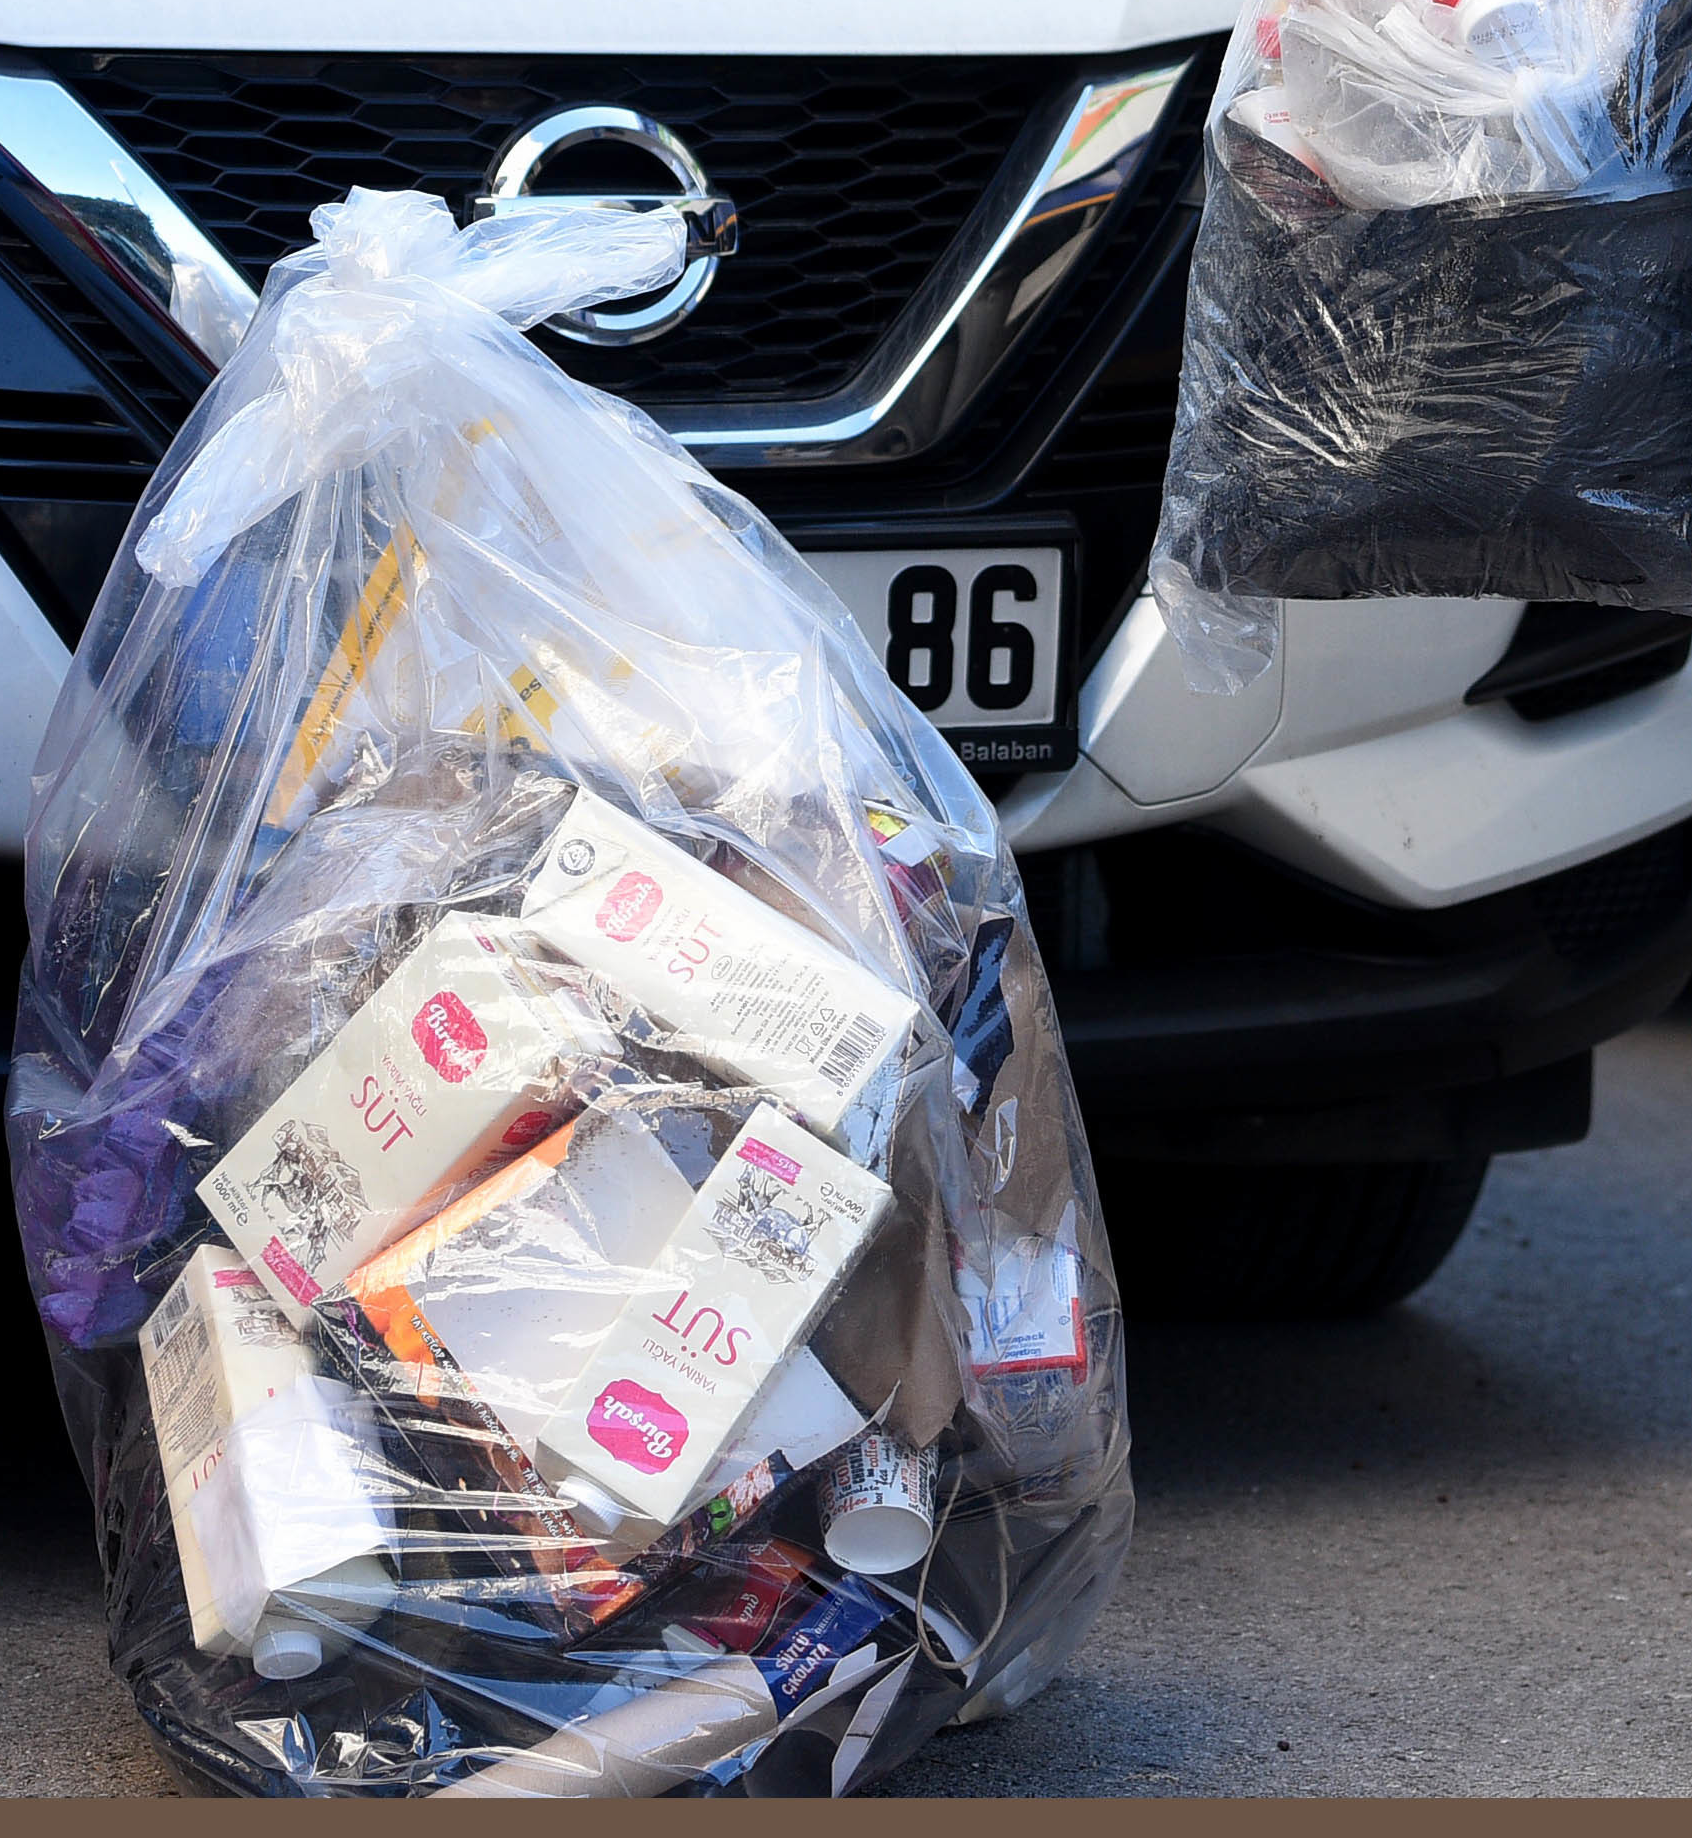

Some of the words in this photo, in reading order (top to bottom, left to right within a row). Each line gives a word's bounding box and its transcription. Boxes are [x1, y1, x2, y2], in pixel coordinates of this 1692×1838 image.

[886, 564, 1037, 712] 86
[960, 741, 1052, 762] Balaban
[668, 914, 723, 983] SÜT
[380, 1053, 404, 1092] YARIM
[350, 1073, 414, 1153] SÜT
[210, 1177, 233, 1202] 1000
[226, 1201, 240, 1215] ml
[843, 1197, 867, 1217] 1000
[408, 1313, 426, 1333] TAT
[652, 1290, 752, 1366] SÜT
[642, 1337, 679, 1370] YAĞLI
[678, 1361, 717, 1395] YARIM
[603, 1394, 674, 1460] Birşah
[864, 1439, 879, 1467] coffee
[521, 1466, 538, 1485] TAT
[775, 1630, 812, 1672] SÜTLÜ
